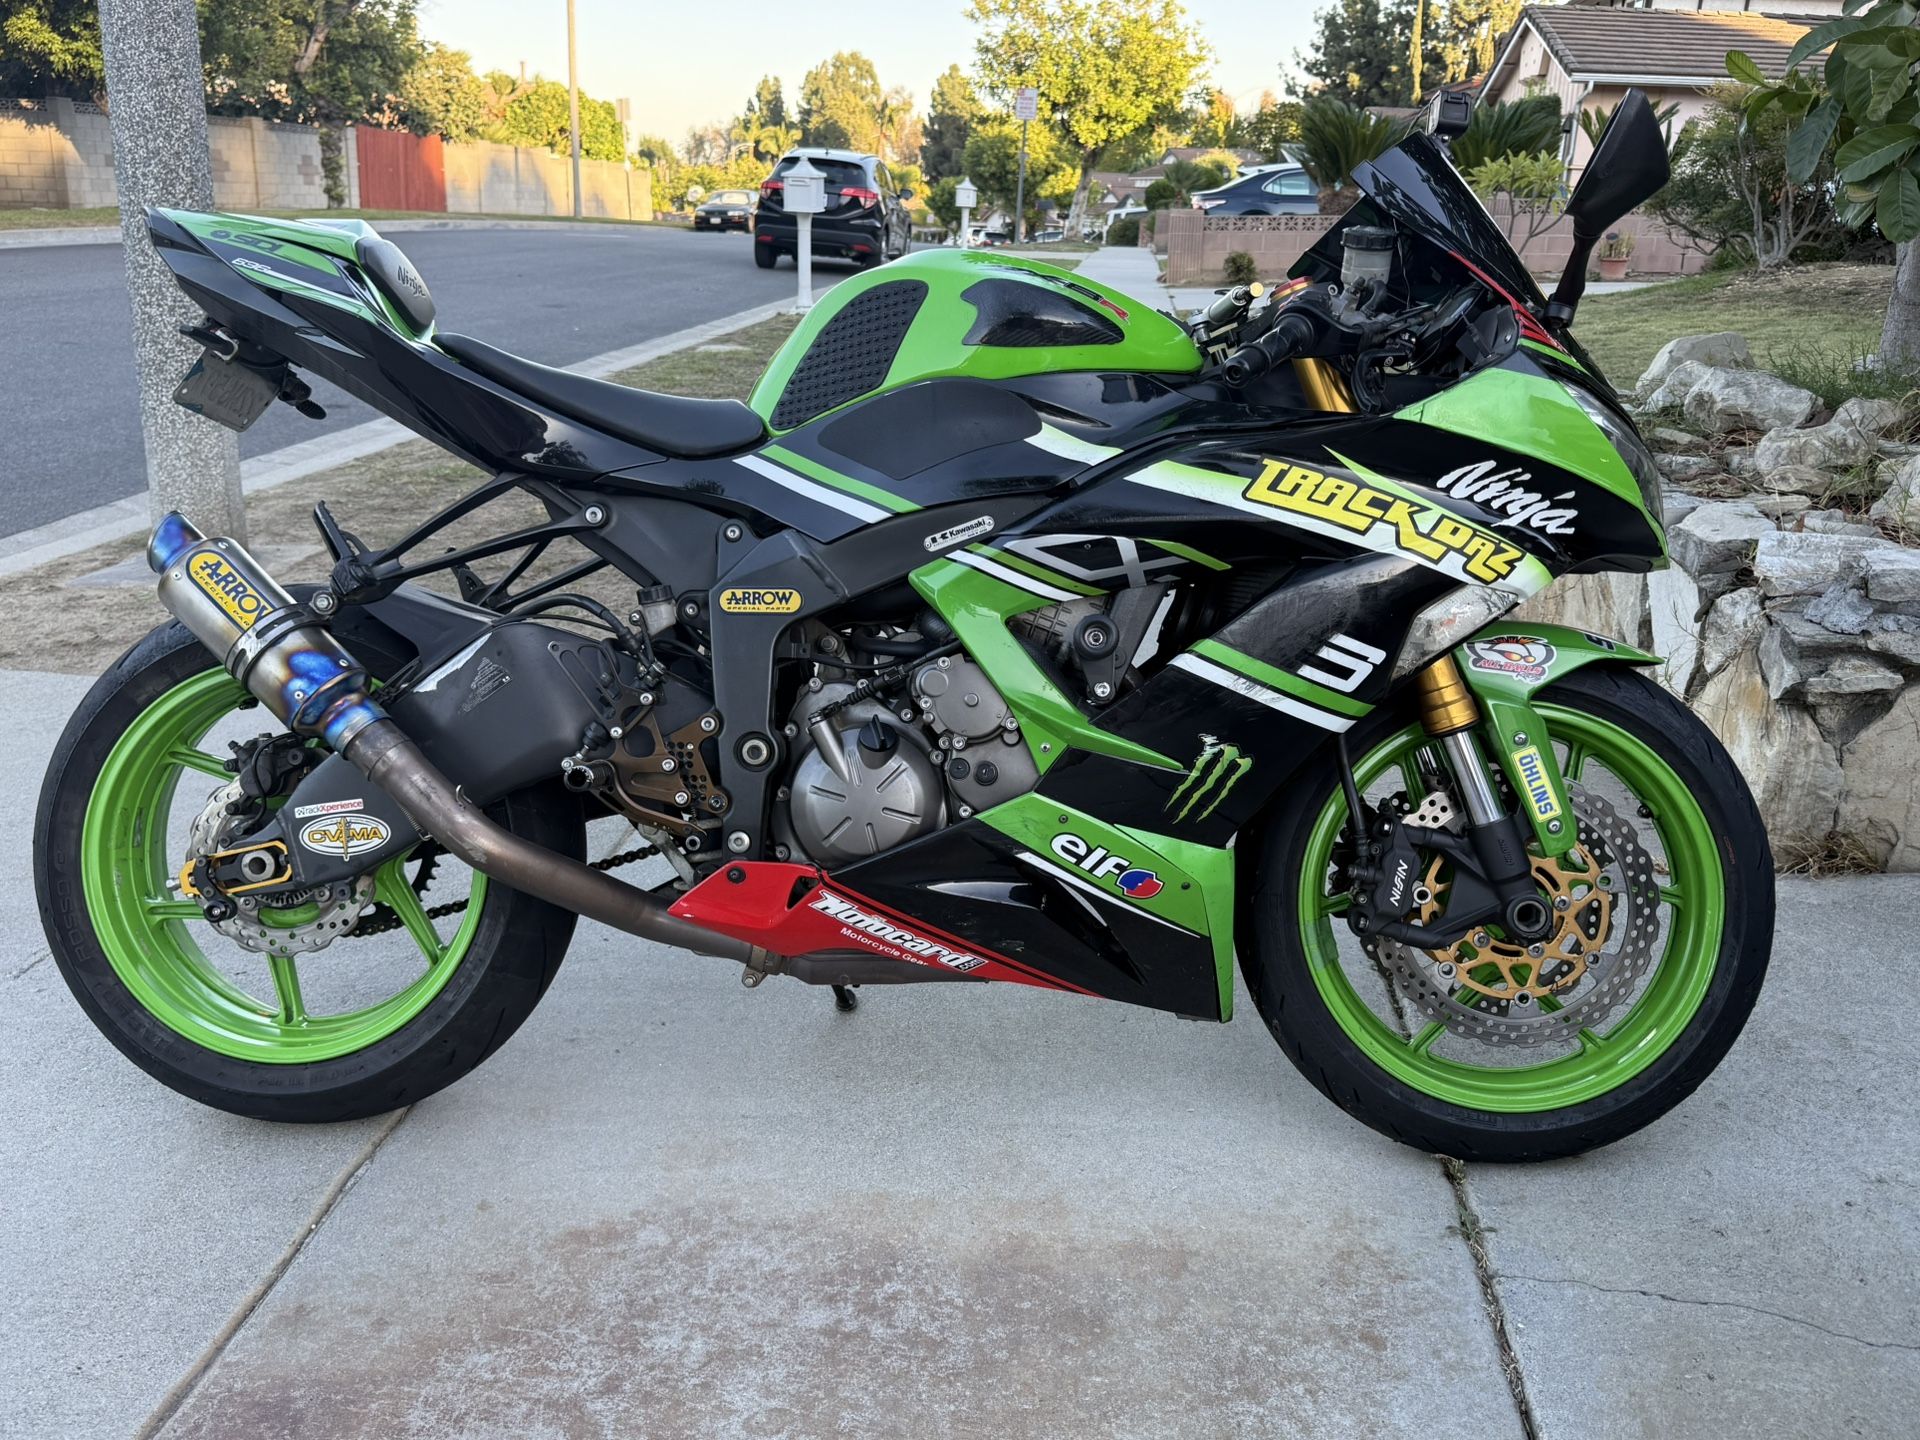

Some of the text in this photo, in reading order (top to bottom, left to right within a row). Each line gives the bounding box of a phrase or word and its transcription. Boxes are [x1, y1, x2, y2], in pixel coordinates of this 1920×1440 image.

[396, 266, 426, 298] Ninja
[1436, 459, 1579, 535] Ninja
[948, 518, 986, 537] Kawasaki
[725, 591, 794, 605] ARROW
[1518, 752, 1554, 815] ÖHLINS
[1051, 833, 1130, 878] elf
[1390, 859, 1409, 907] NISSIN
[809, 890, 973, 971] Motocard
[840, 927, 929, 966] Motorcycle Gear
